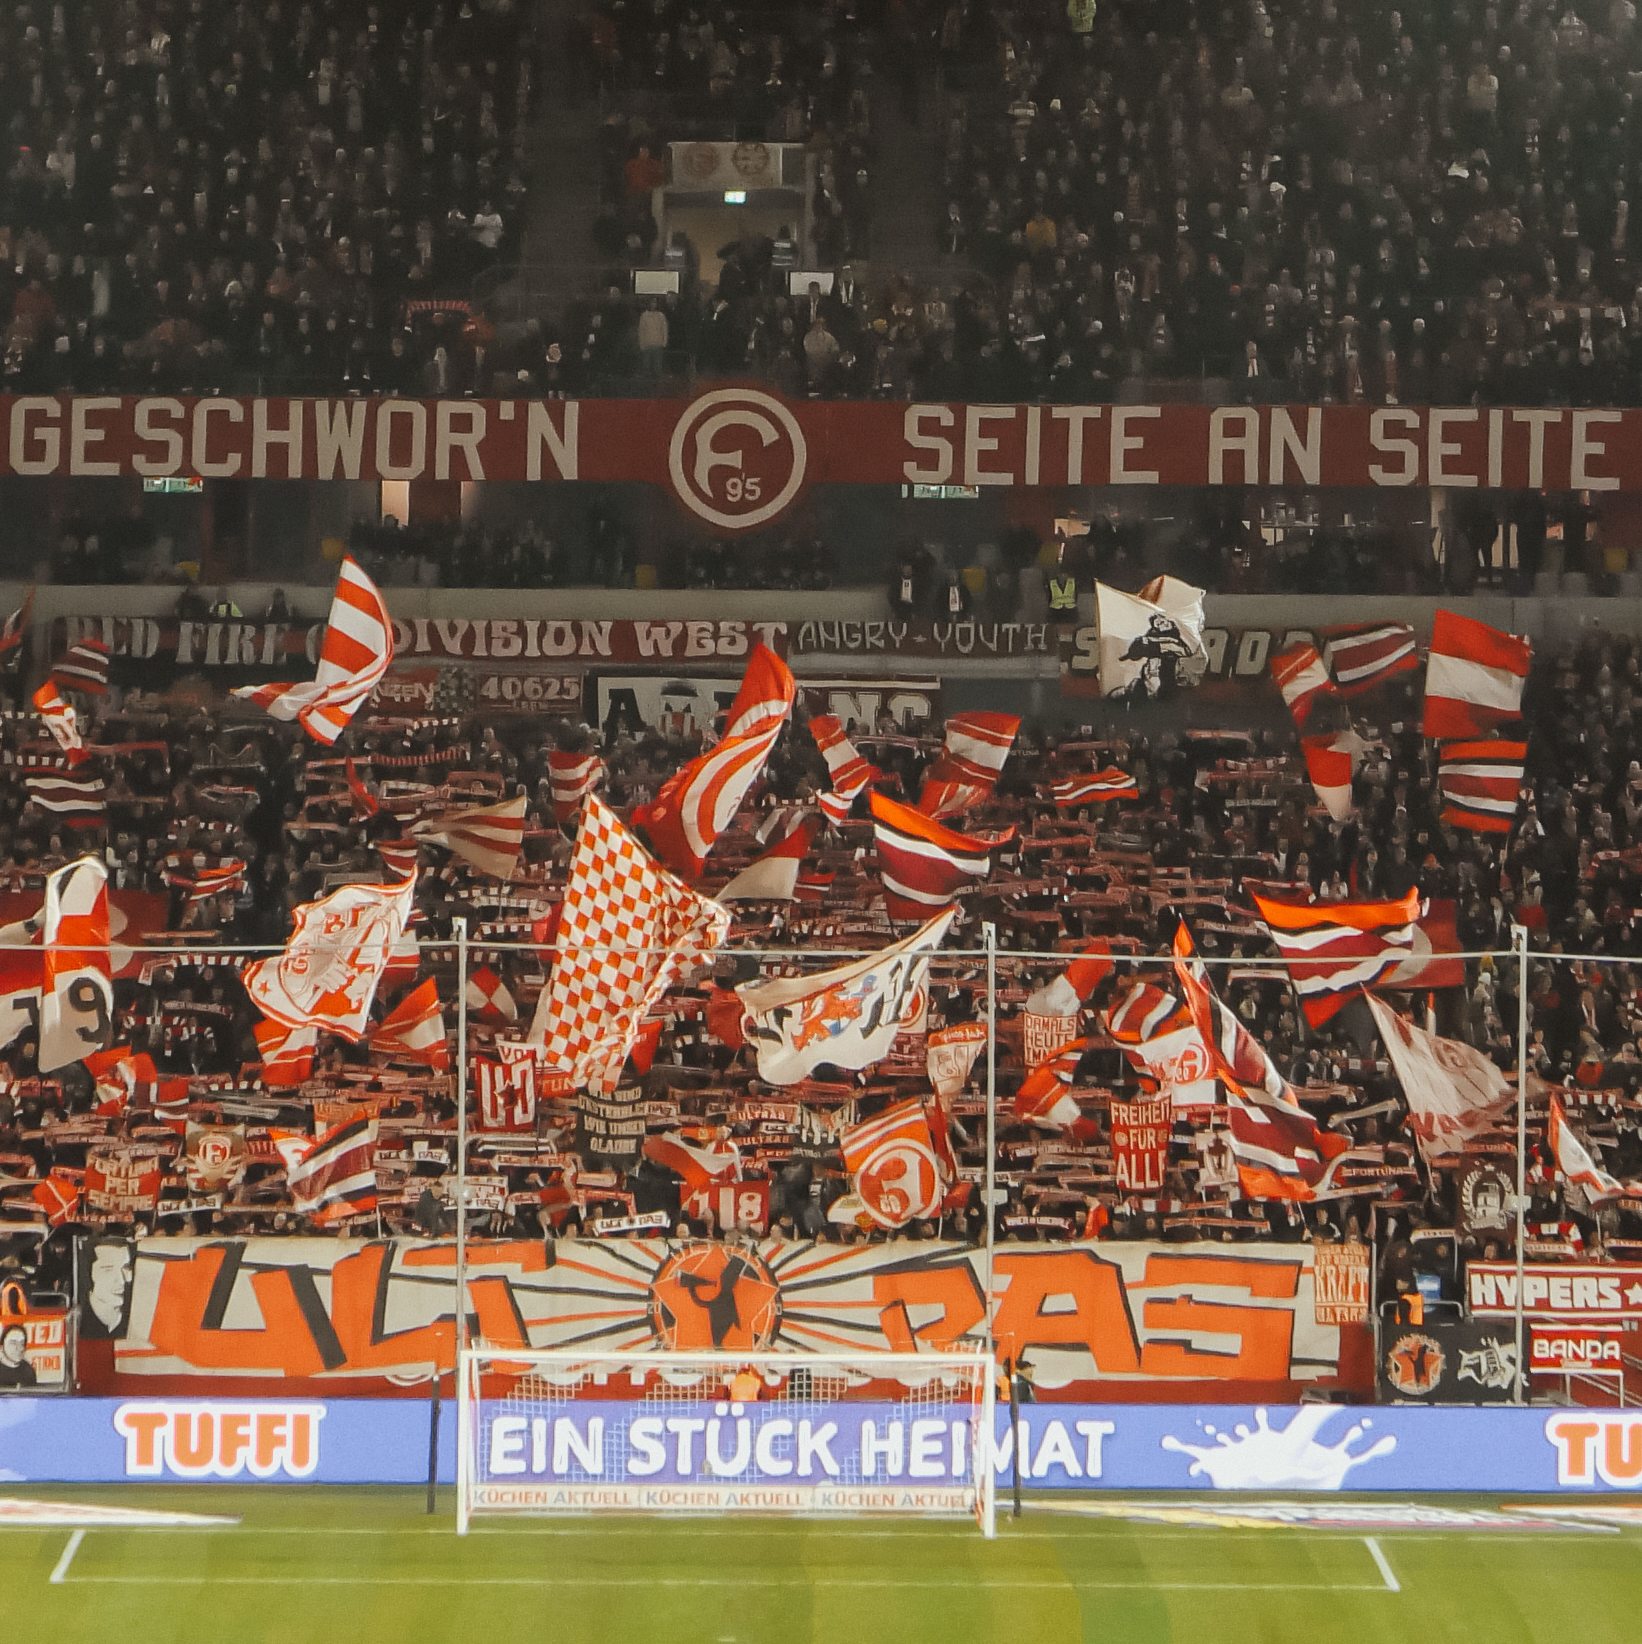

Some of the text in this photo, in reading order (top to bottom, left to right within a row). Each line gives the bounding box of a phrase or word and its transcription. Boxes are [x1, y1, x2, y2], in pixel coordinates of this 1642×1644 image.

[8, 397, 580, 481] GESCHWOR'N
[903, 404, 1162, 486] SEITE
[1207, 406, 1323, 486] AN
[1368, 407, 1622, 491] SEITE
[175, 620, 291, 666] FIRE
[392, 618, 788, 658] DIVISION WEST
[798, 625, 908, 652] ANGRY
[932, 623, 1049, 653] YOUTH
[480, 676, 581, 701] 40625
[1110, 1098, 1171, 1126] FREIHEIT
[106, 1176, 140, 1195] PER
[1471, 1274, 1622, 1309] HYPERS
[1533, 1339, 1621, 1361] BANDA
[118, 1409, 319, 1474] TUFFI
[489, 1403, 1115, 1479] EIN STÜCK HEIMAT
[474, 1489, 632, 1505] KÜCHEN AKTUELL
[645, 1490, 801, 1506] KÜCHEN AKTUELL
[821, 1492, 973, 1508] KÜCHEN AKTUEL
